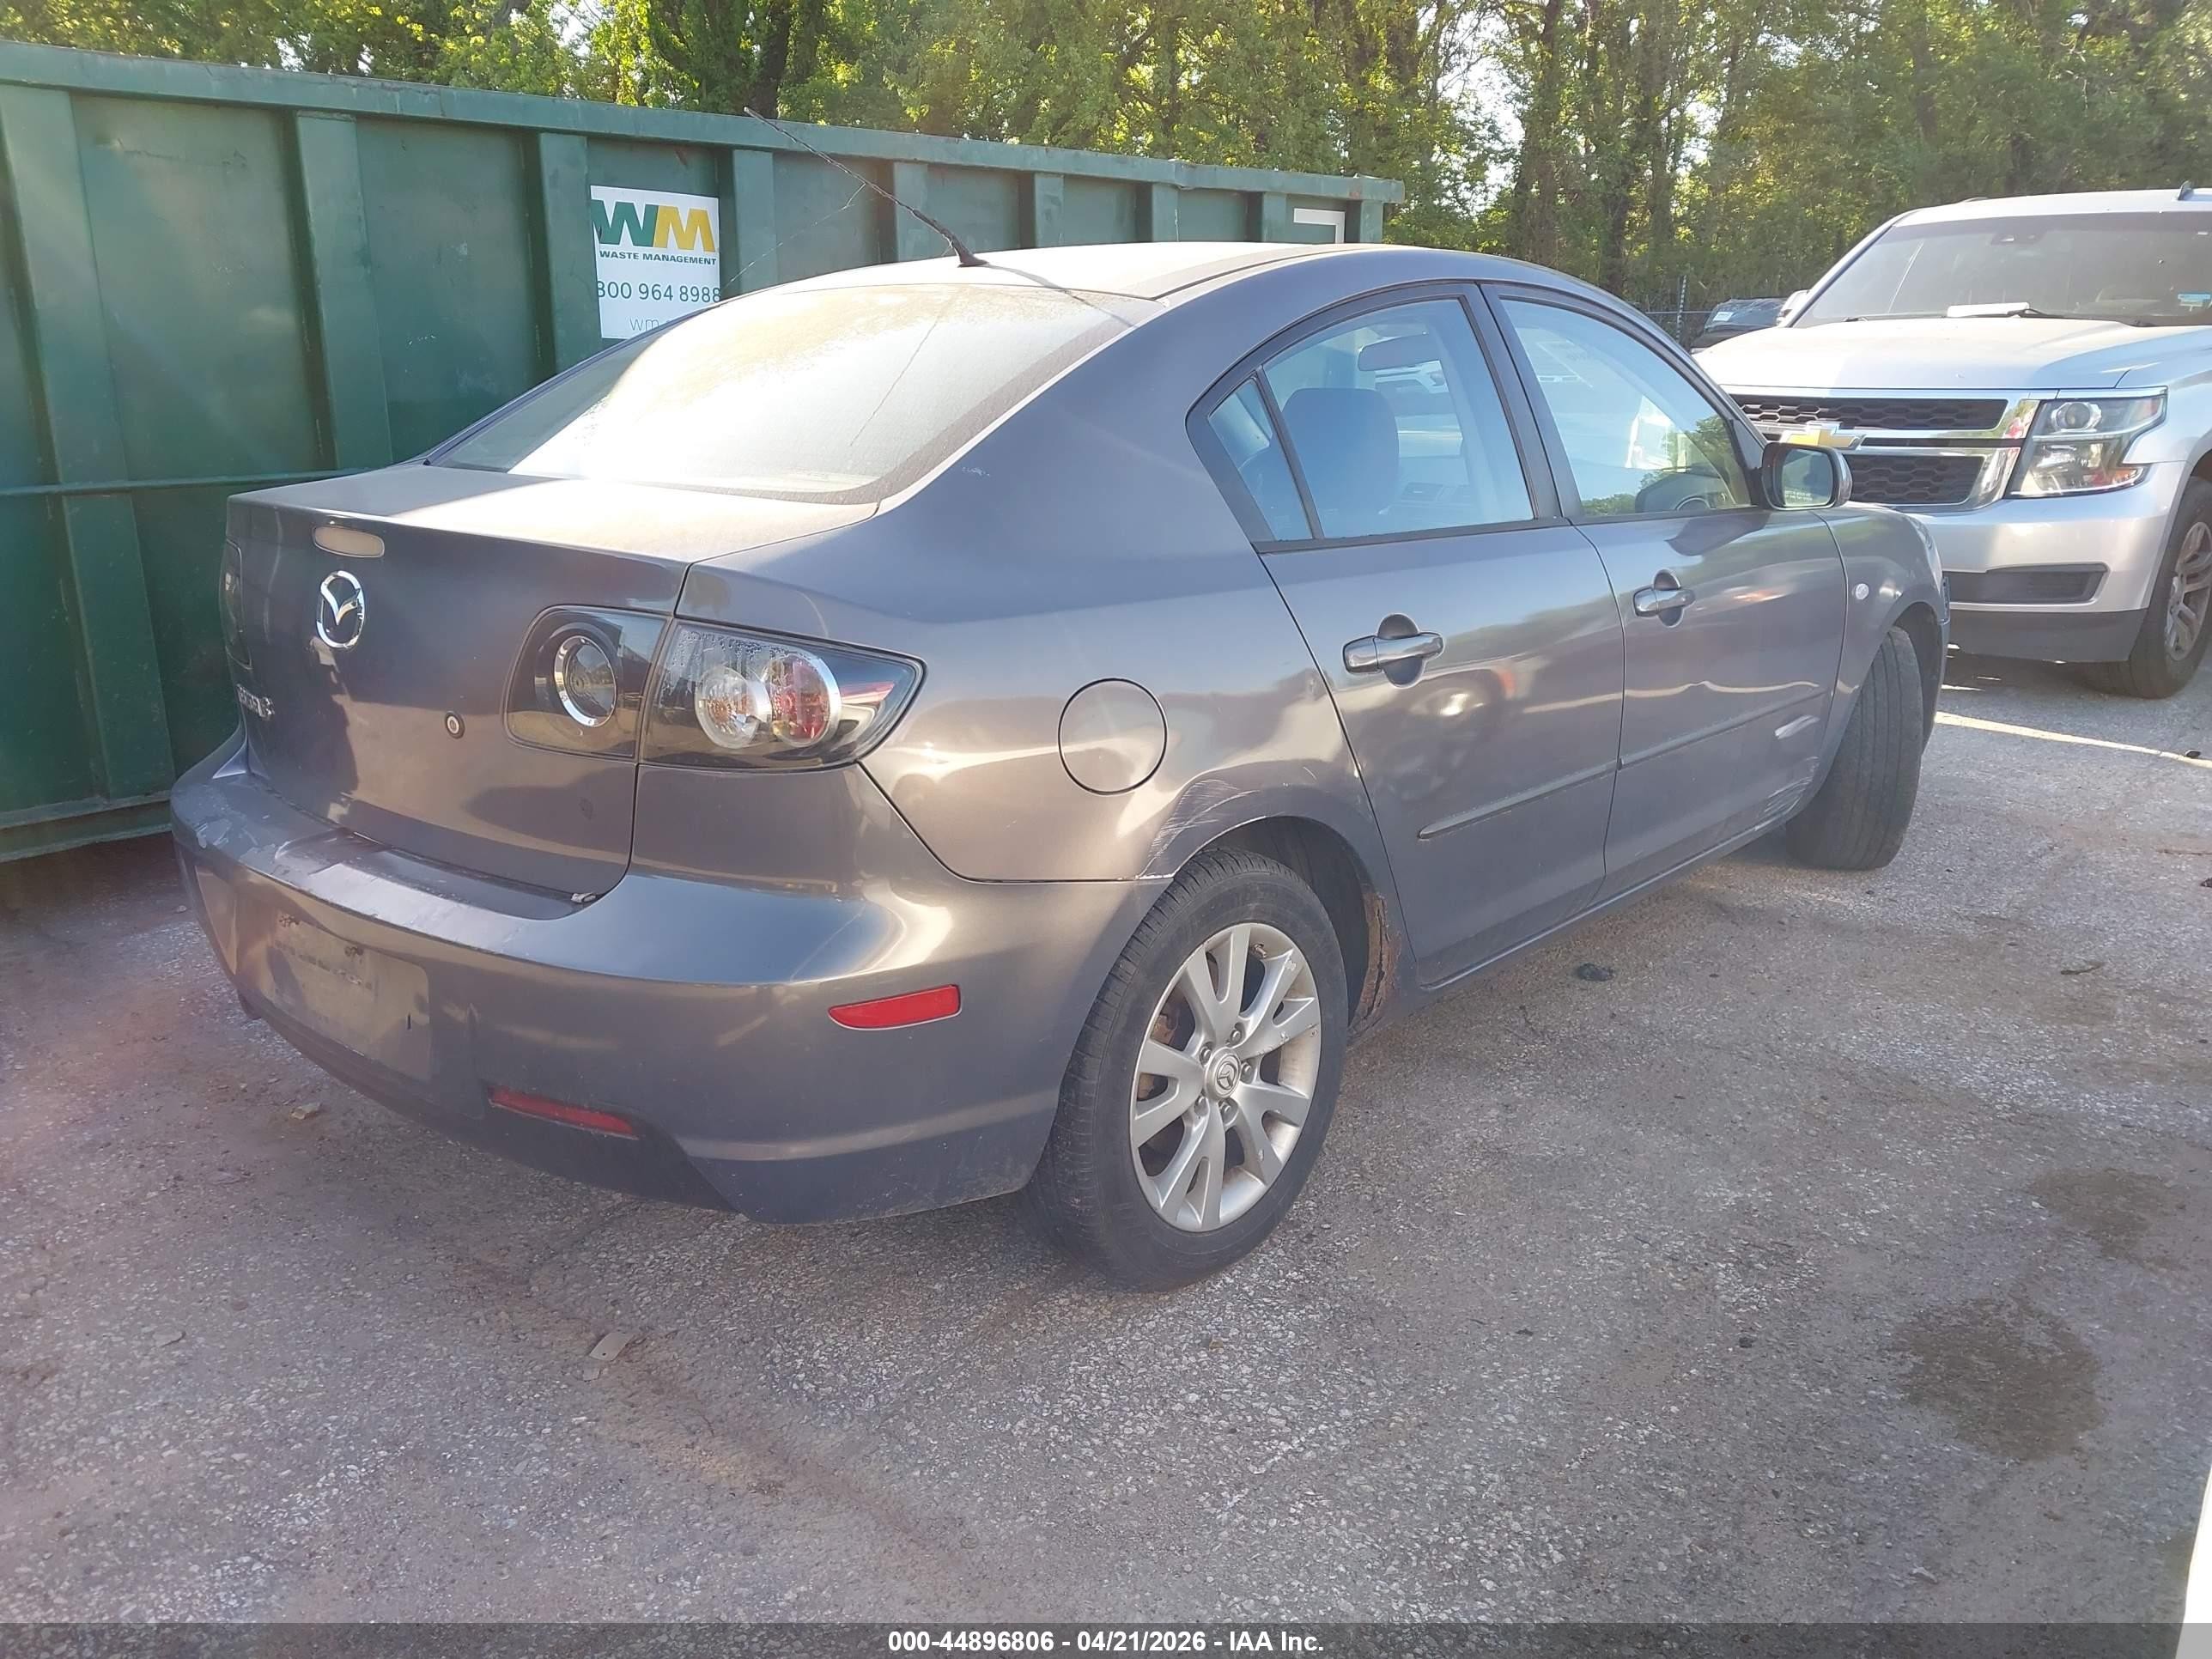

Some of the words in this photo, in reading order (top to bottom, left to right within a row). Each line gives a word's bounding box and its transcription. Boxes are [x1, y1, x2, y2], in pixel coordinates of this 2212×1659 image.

[590, 199, 715, 252] WM
[599, 250, 640, 260] WASTE
[642, 252, 717, 265] MANAGEMENT
[597, 280, 632, 299] 800
[638, 283, 674, 301] 964
[679, 285, 721, 303] 8988
